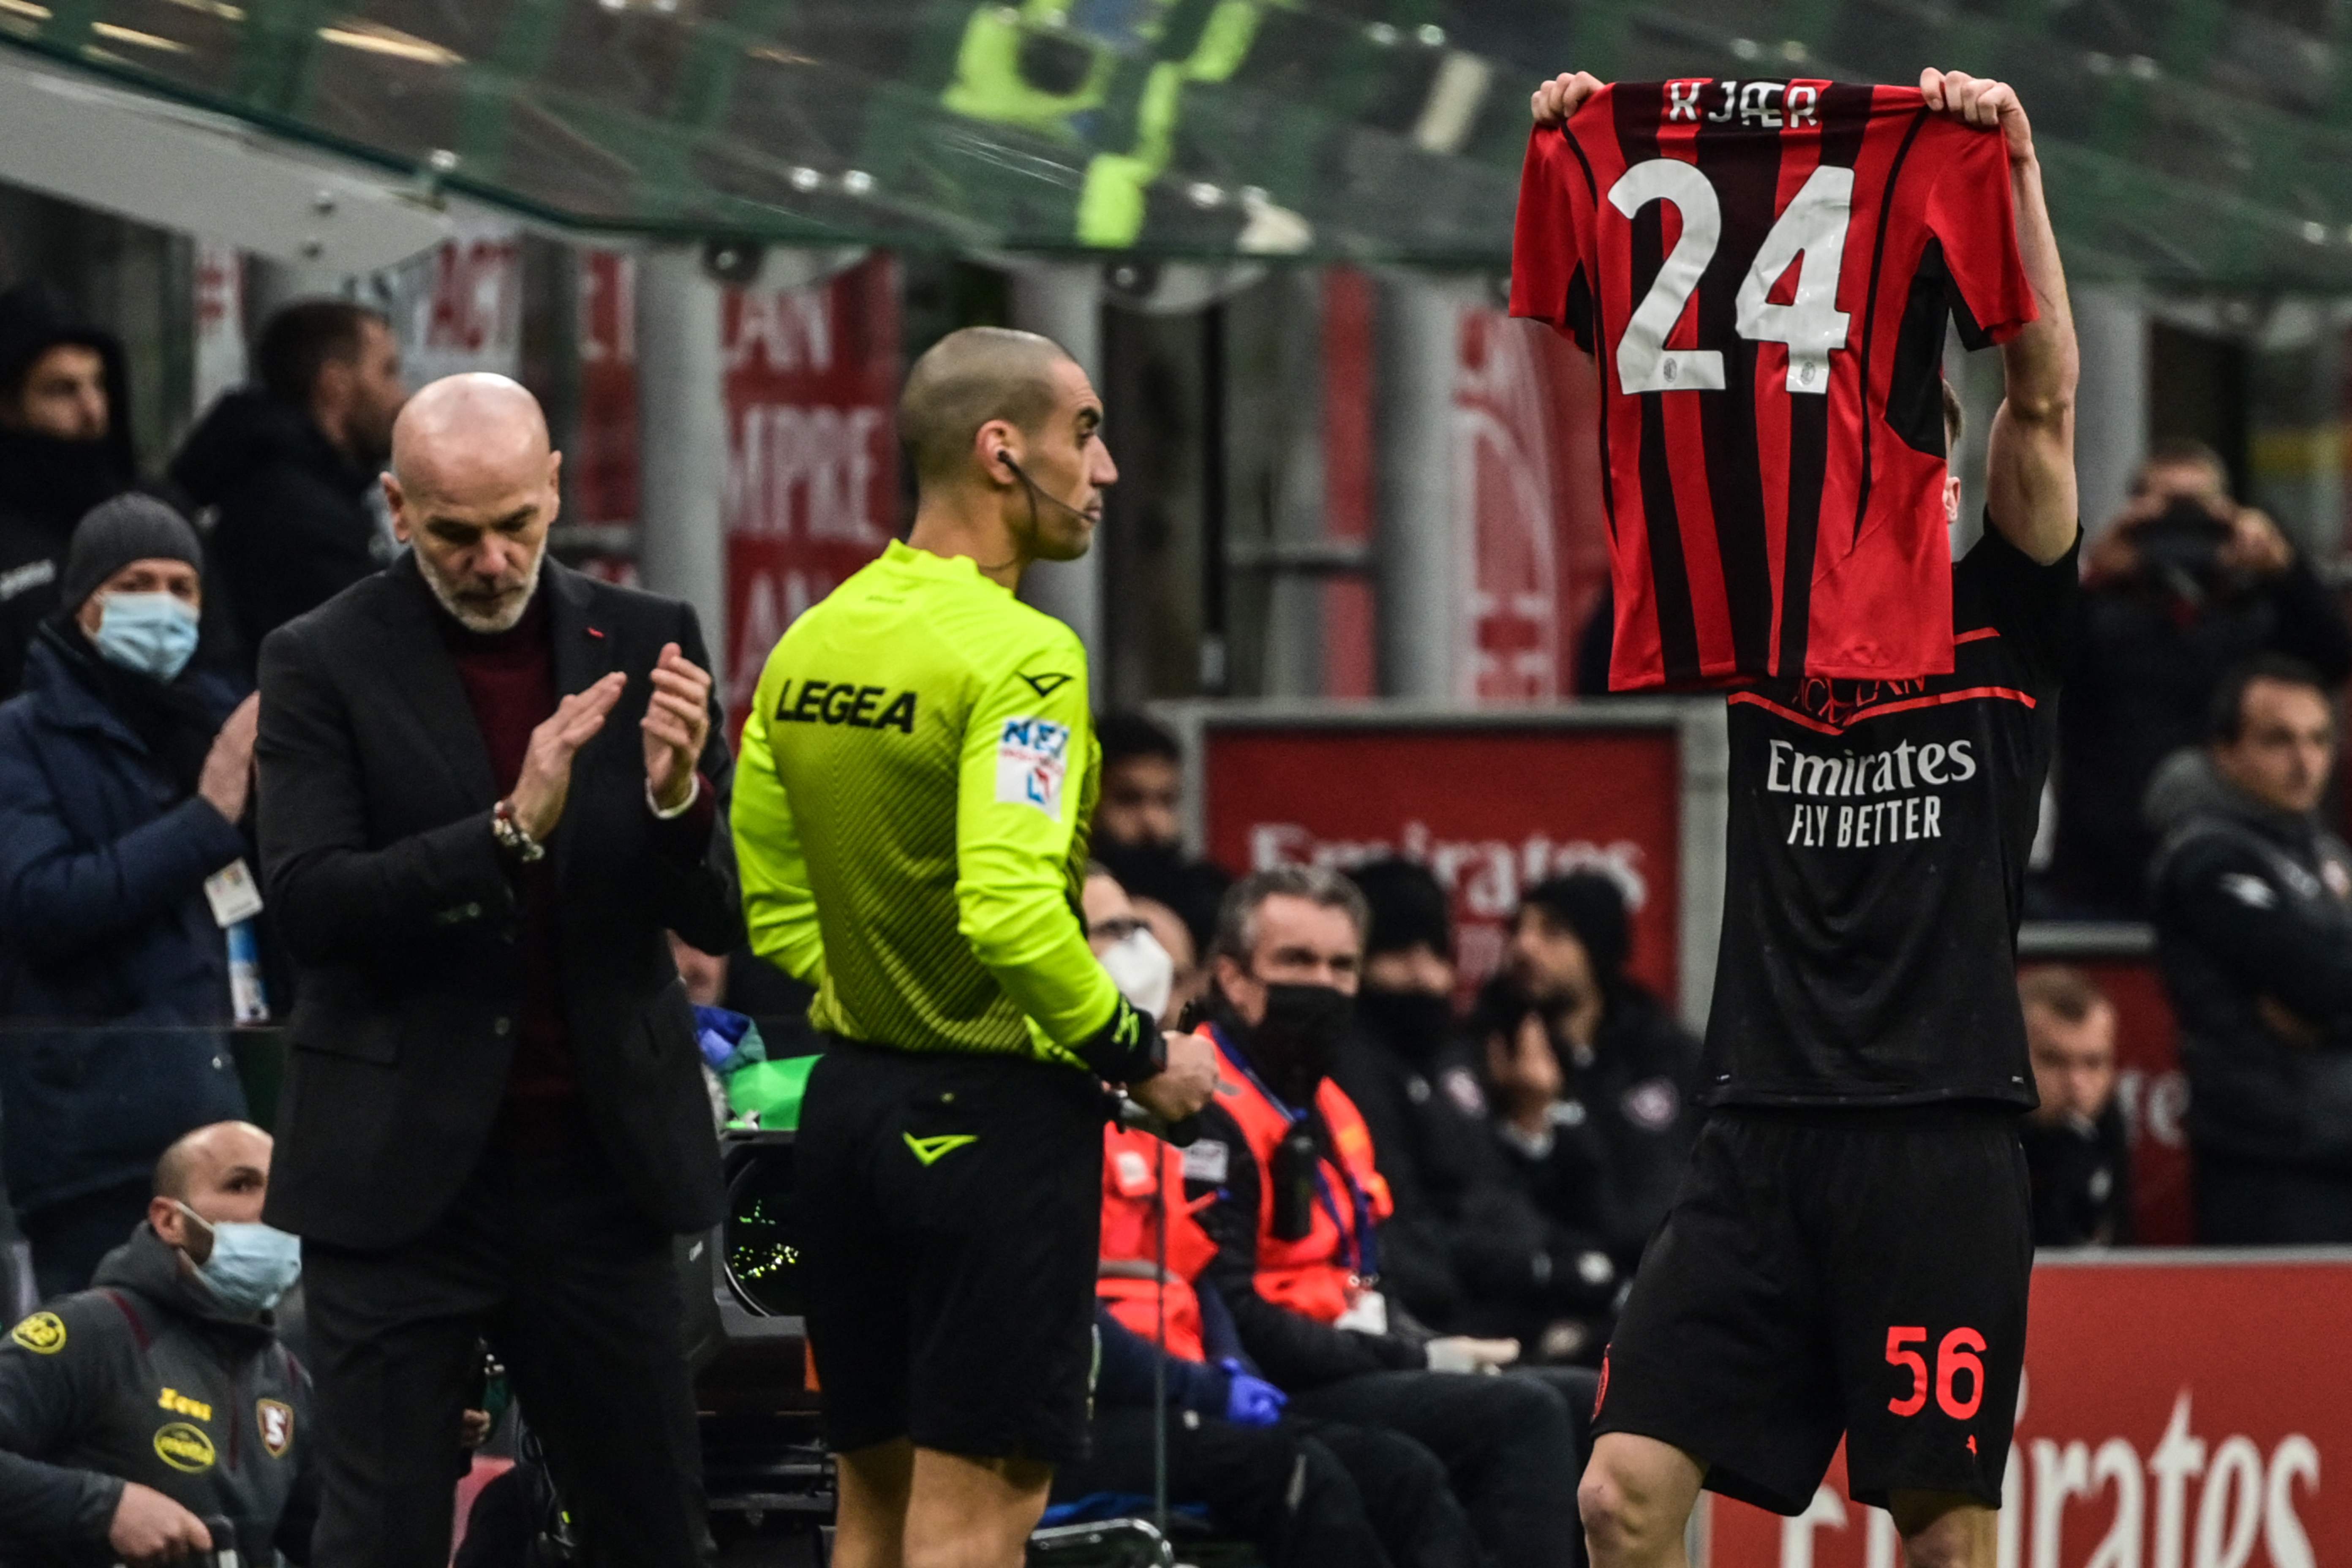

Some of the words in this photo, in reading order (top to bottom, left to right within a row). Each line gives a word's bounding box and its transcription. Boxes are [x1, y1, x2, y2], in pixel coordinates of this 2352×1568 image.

[1669, 80, 1818, 128] KJÆR
[1607, 158, 1854, 395] 24
[776, 679, 917, 733] LEGEA
[1767, 738, 1976, 795] Emirates
[1787, 804, 1828, 847] FLY
[1837, 796, 1941, 847] BETTER
[1885, 1326, 1987, 1420] 56
